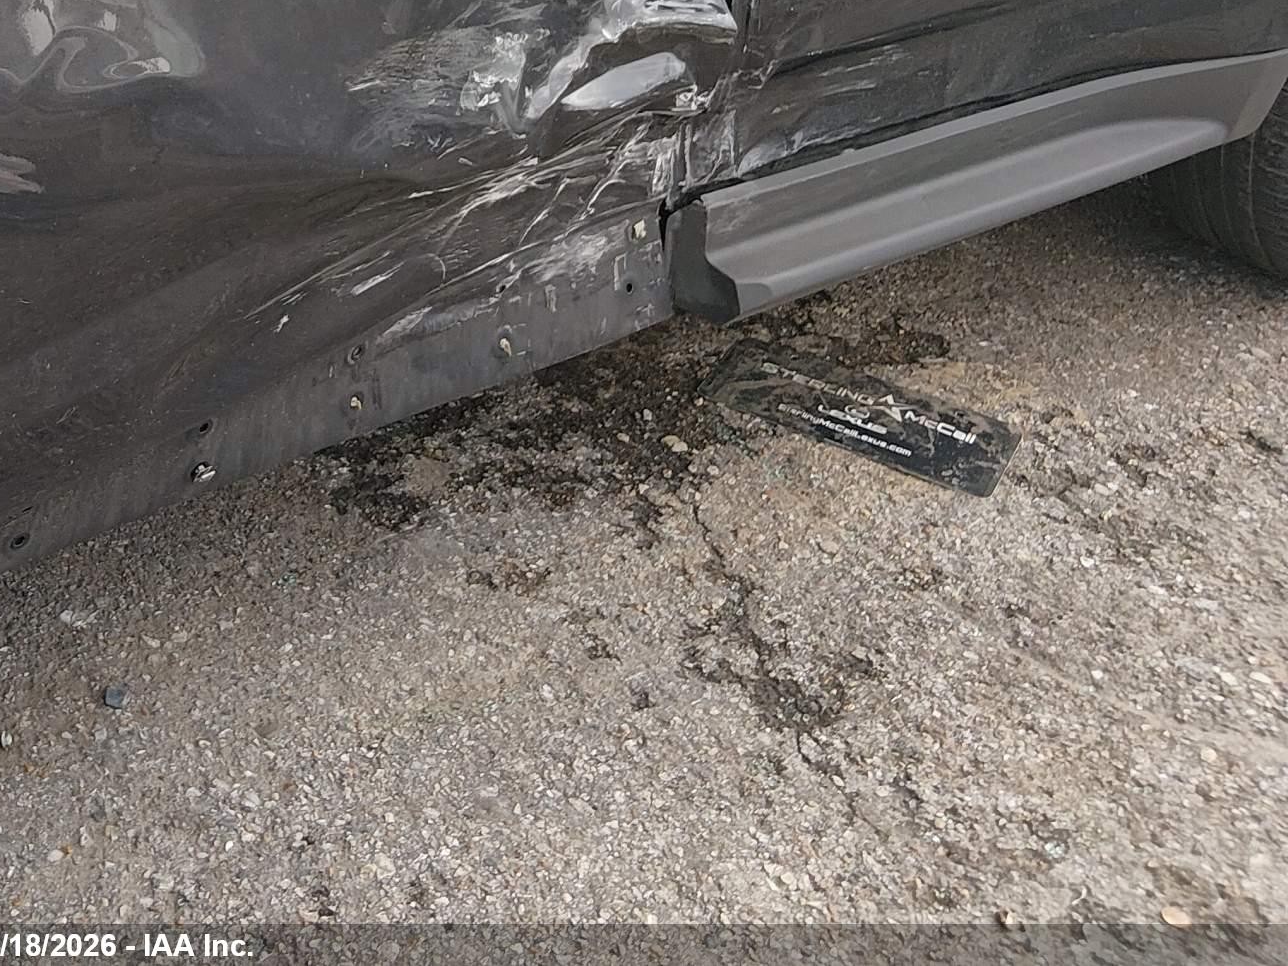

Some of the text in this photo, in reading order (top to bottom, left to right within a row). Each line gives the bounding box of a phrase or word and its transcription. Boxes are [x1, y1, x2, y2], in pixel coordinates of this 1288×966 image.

[761, 362, 977, 444] STERLING McCall
[817, 405, 887, 435] LEXUS
